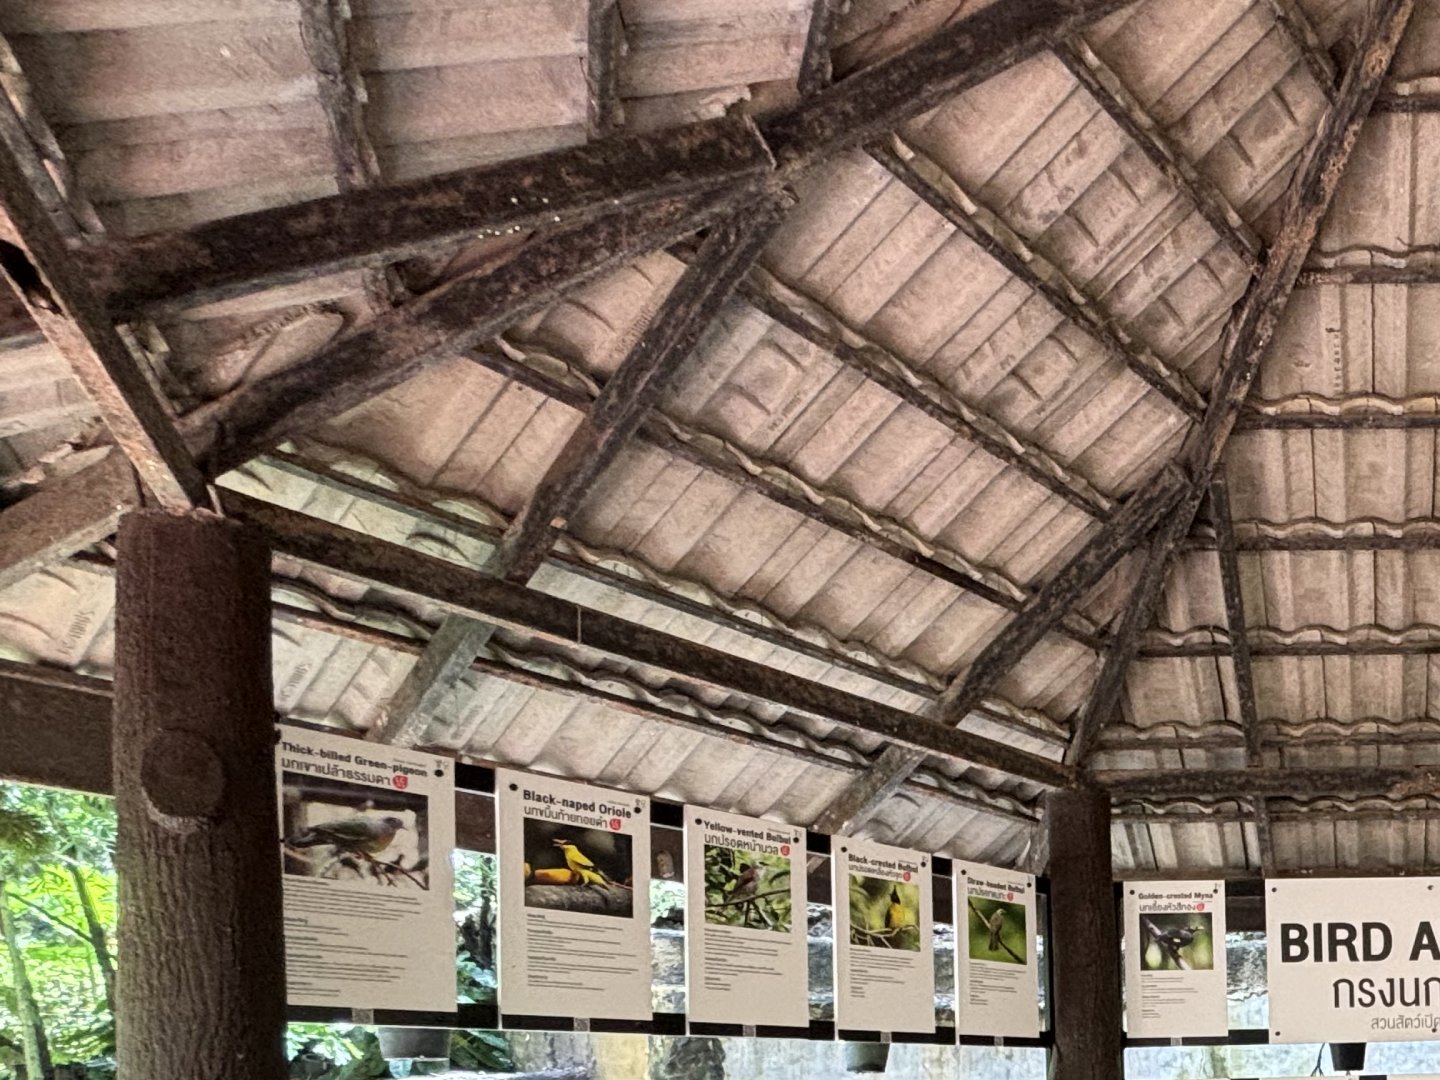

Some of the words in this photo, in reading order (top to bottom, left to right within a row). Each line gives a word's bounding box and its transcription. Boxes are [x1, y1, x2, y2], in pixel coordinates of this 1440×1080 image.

[282, 741, 351, 764] Thick-billed
[355, 756, 428, 777] Green-pigeon
[523, 789, 596, 812] Black-naped
[600, 803, 632, 819] Oriole
[704, 821, 764, 840] Yellow-vented
[767, 832, 791, 844] Bulbul
[1194, 892, 1214, 901] Myna
[1280, 922, 1393, 963] BIRD
